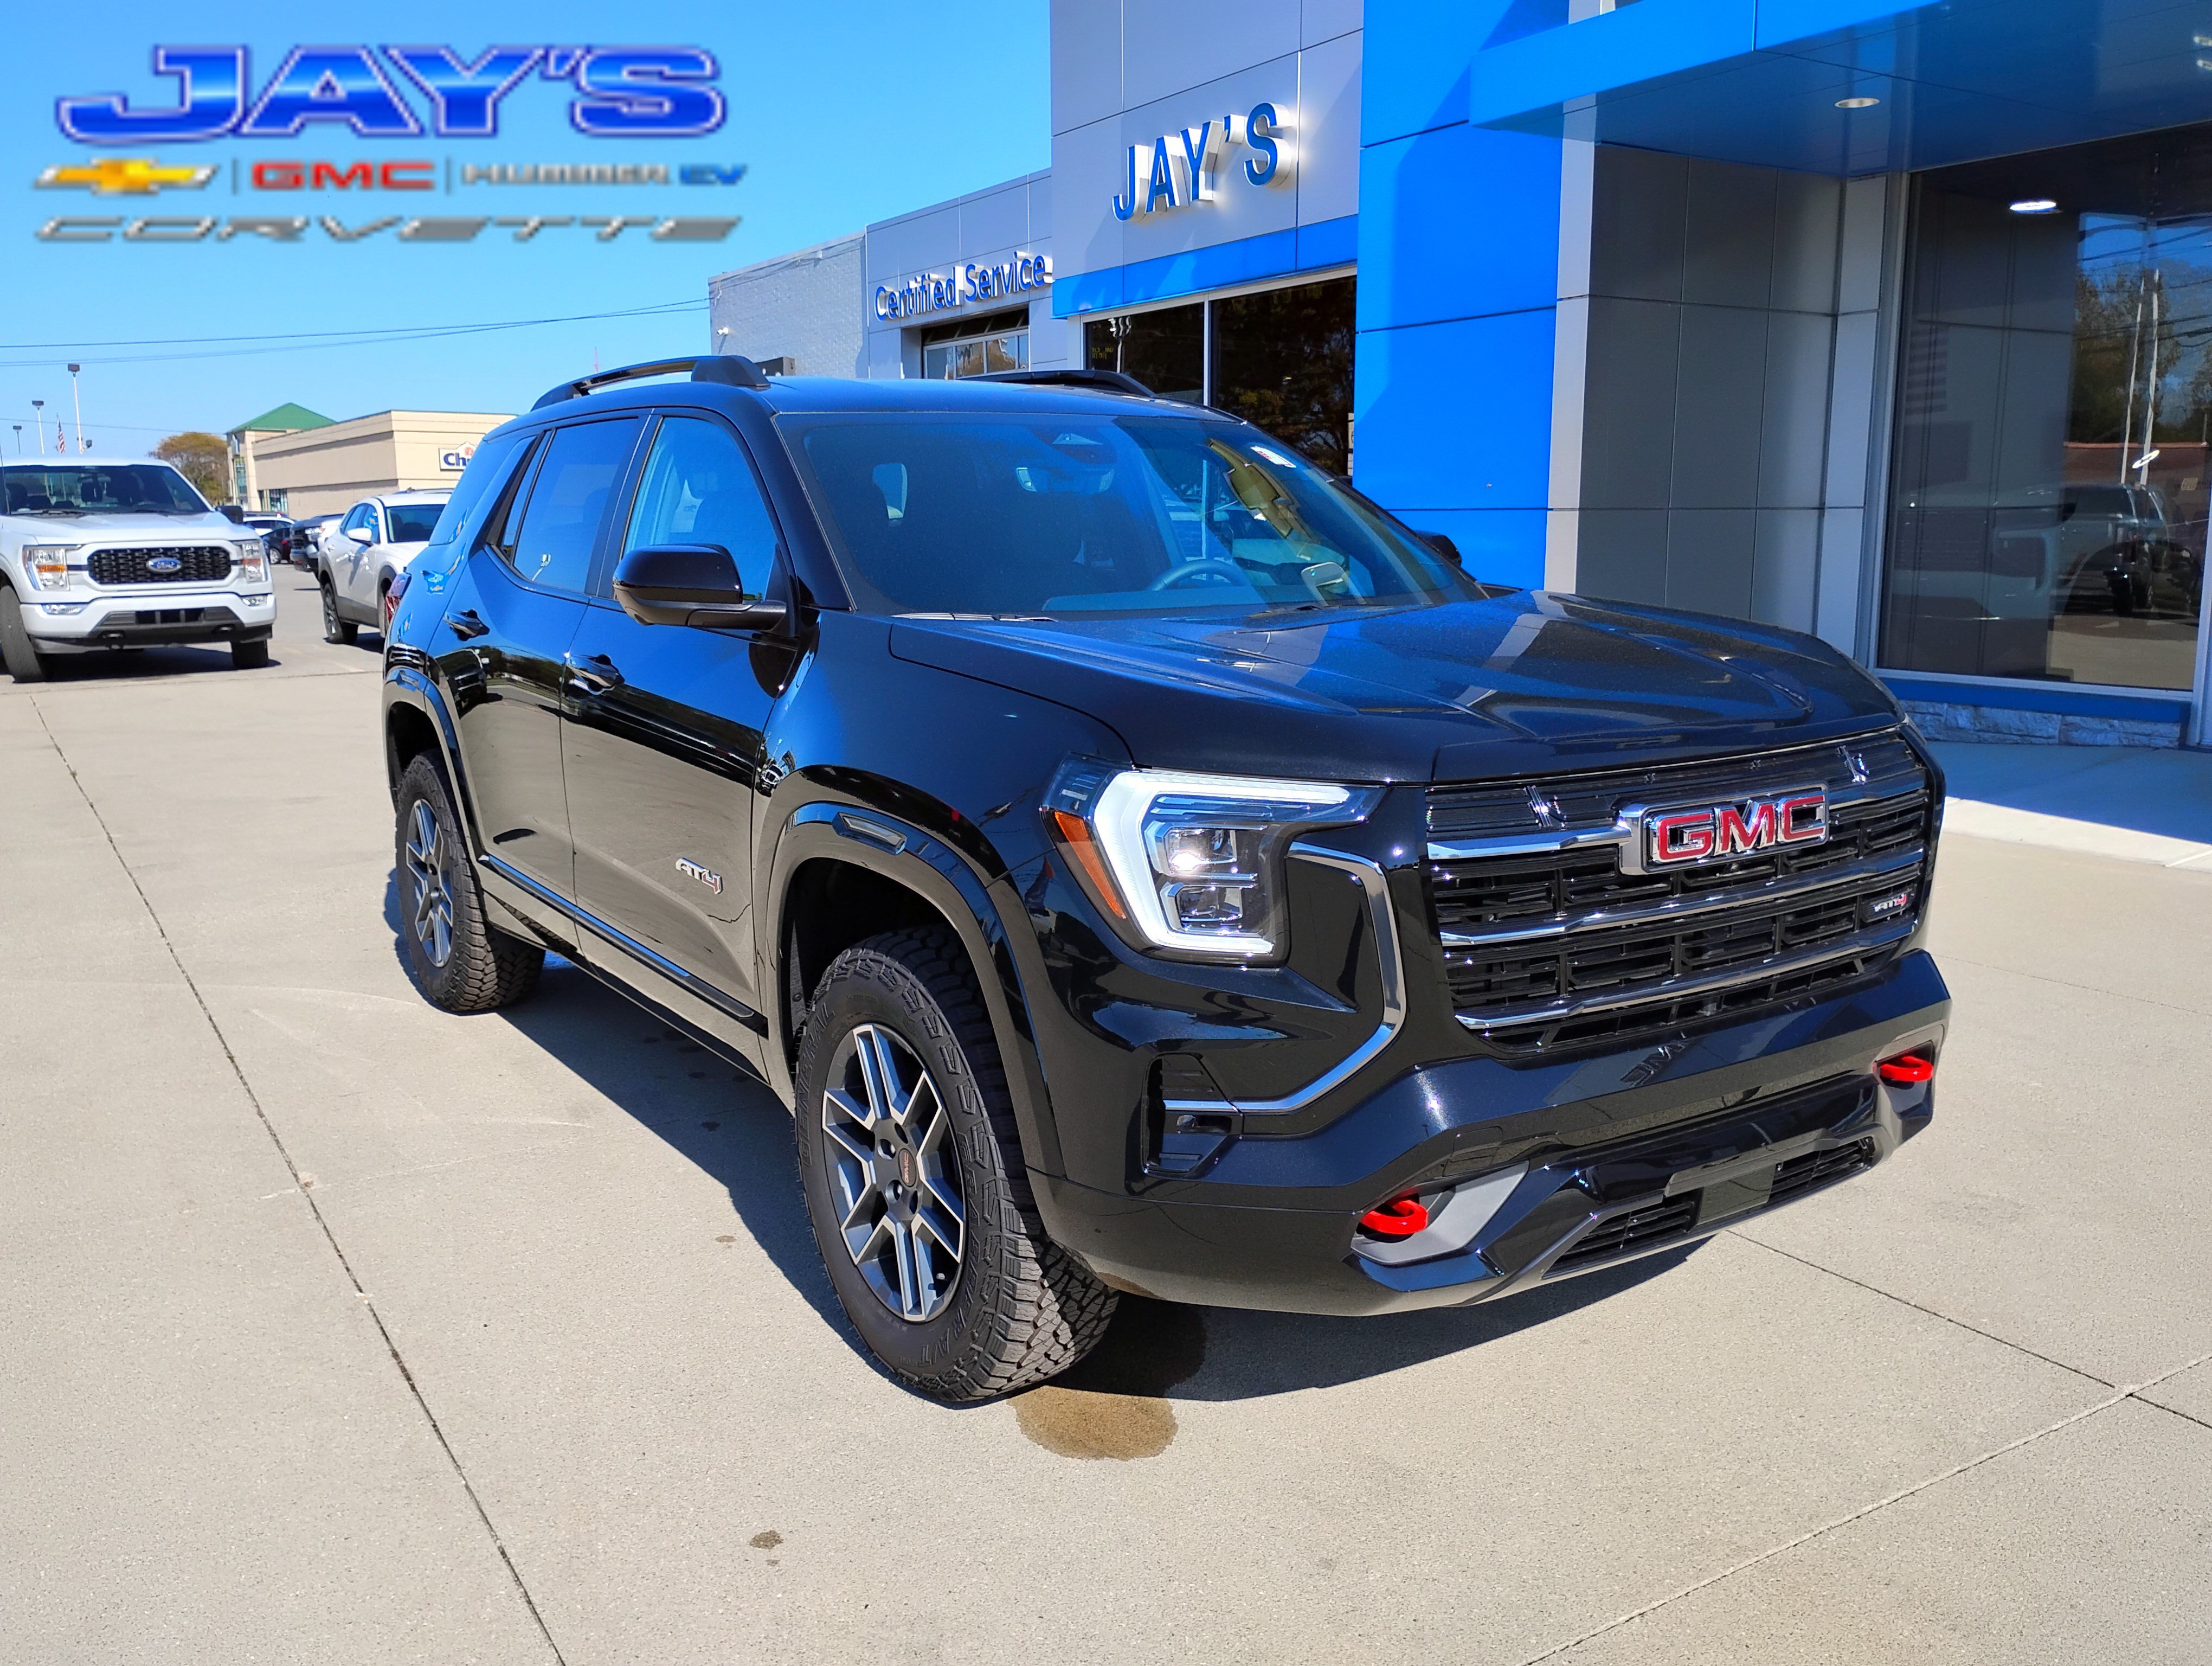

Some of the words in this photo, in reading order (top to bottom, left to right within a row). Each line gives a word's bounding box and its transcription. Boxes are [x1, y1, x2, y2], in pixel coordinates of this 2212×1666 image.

[1112, 101, 1292, 222] JAY'S
[874, 266, 964, 321] Certified
[964, 250, 1053, 303] Service
[1652, 793, 1827, 863] GMC
[676, 857, 723, 895] AT4
[1874, 893, 1907, 912] AT4
[798, 1002, 835, 1167] GENERAL
